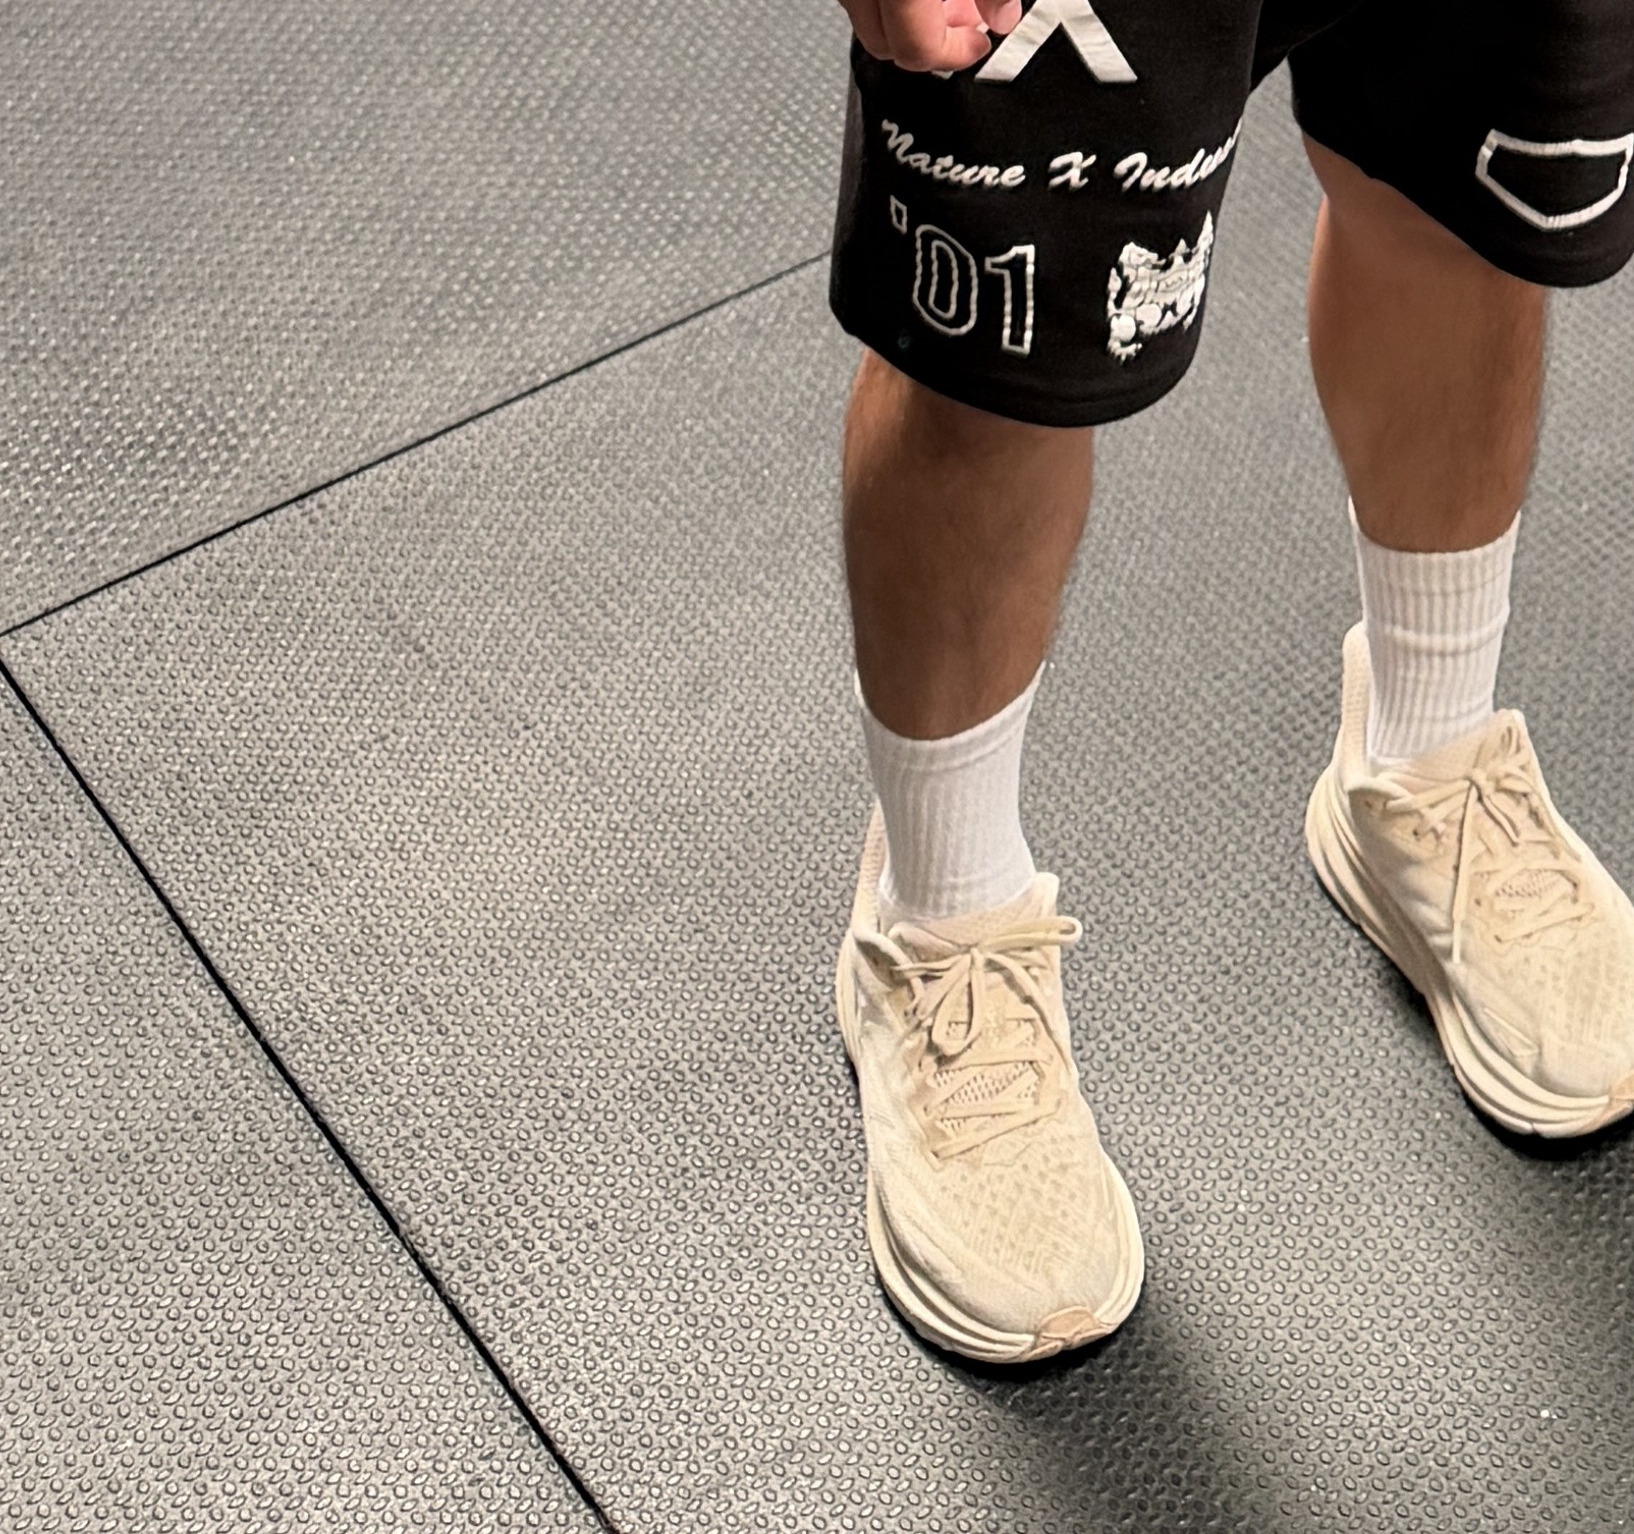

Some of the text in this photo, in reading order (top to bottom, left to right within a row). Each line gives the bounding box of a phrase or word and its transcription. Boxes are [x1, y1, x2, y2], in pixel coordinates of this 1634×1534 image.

[881, 118, 1027, 189] Nature
[1047, 150, 1098, 191] X
[890, 194, 1036, 357] '01
